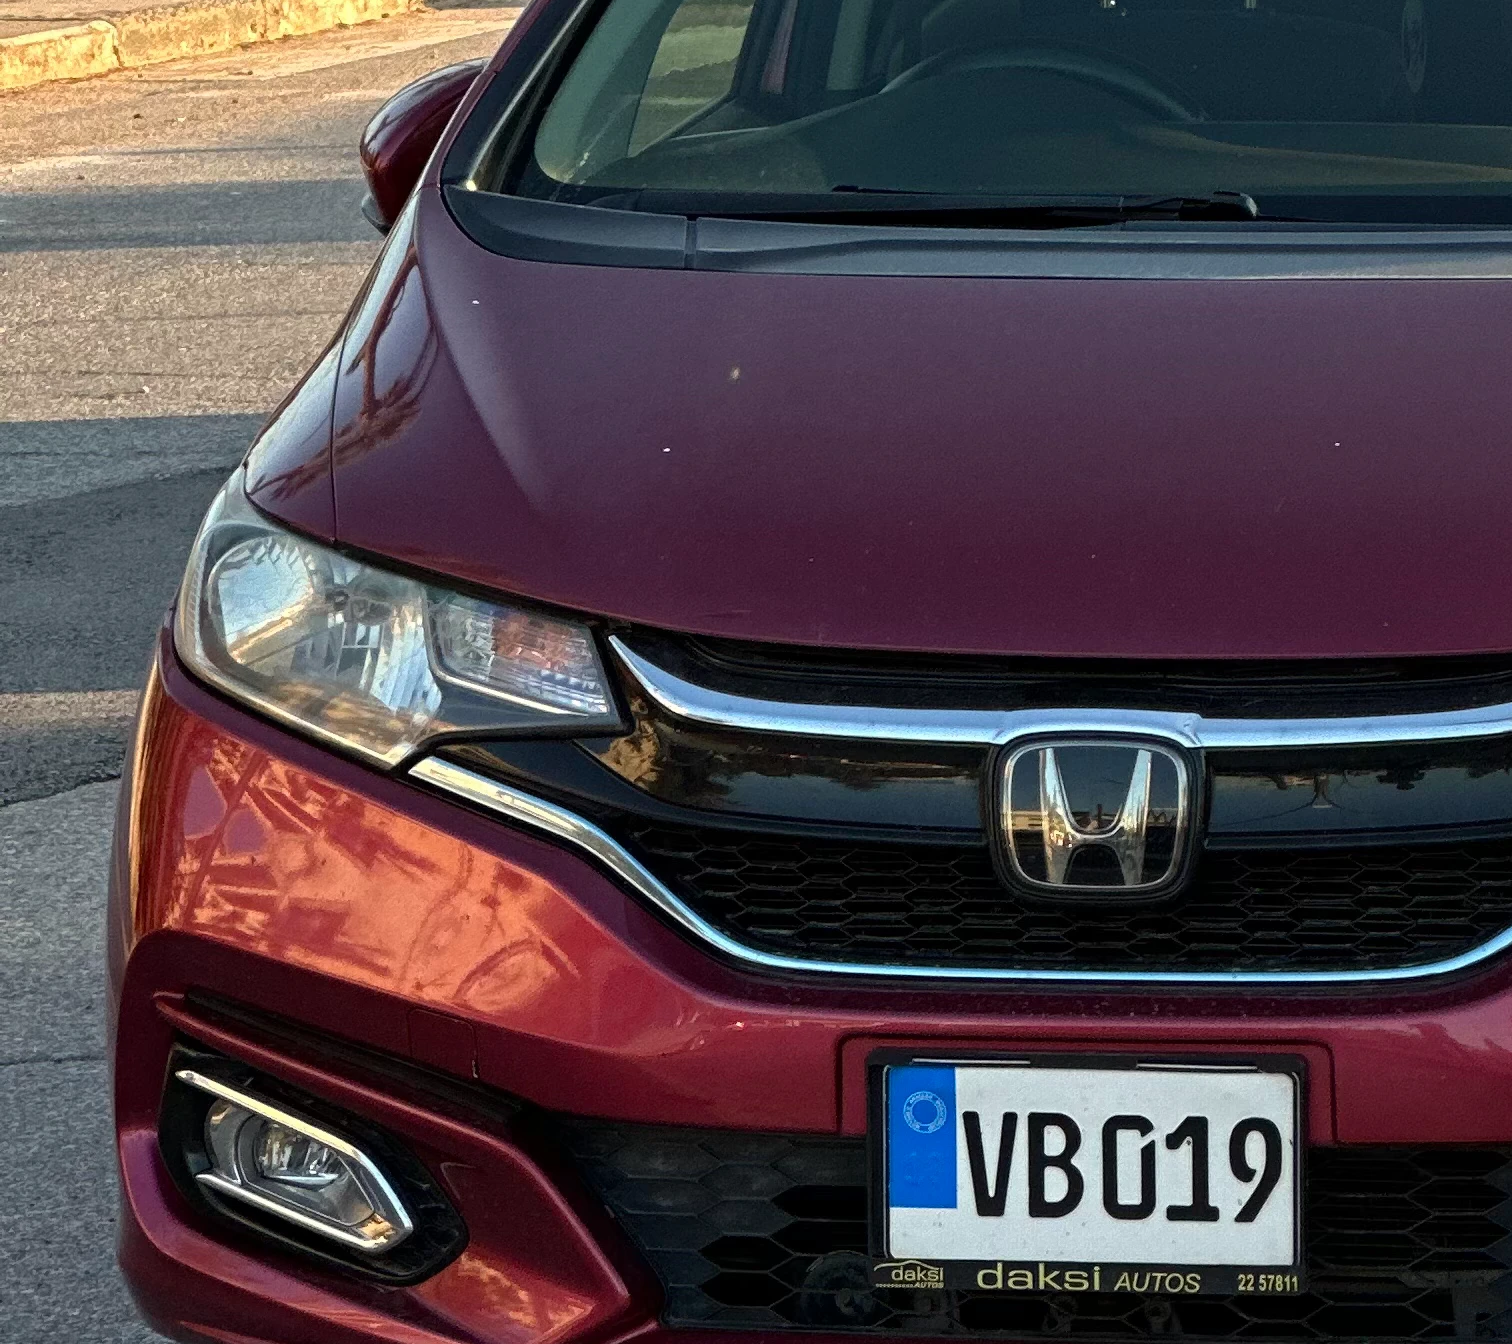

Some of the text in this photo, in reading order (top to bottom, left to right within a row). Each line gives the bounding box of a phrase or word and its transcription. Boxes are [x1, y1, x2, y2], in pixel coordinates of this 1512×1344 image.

[891, 1265, 944, 1282] daksi
[976, 1262, 1298, 1293] daksi AUTOS 22 57811
[913, 1281, 944, 1289] AUTOS
